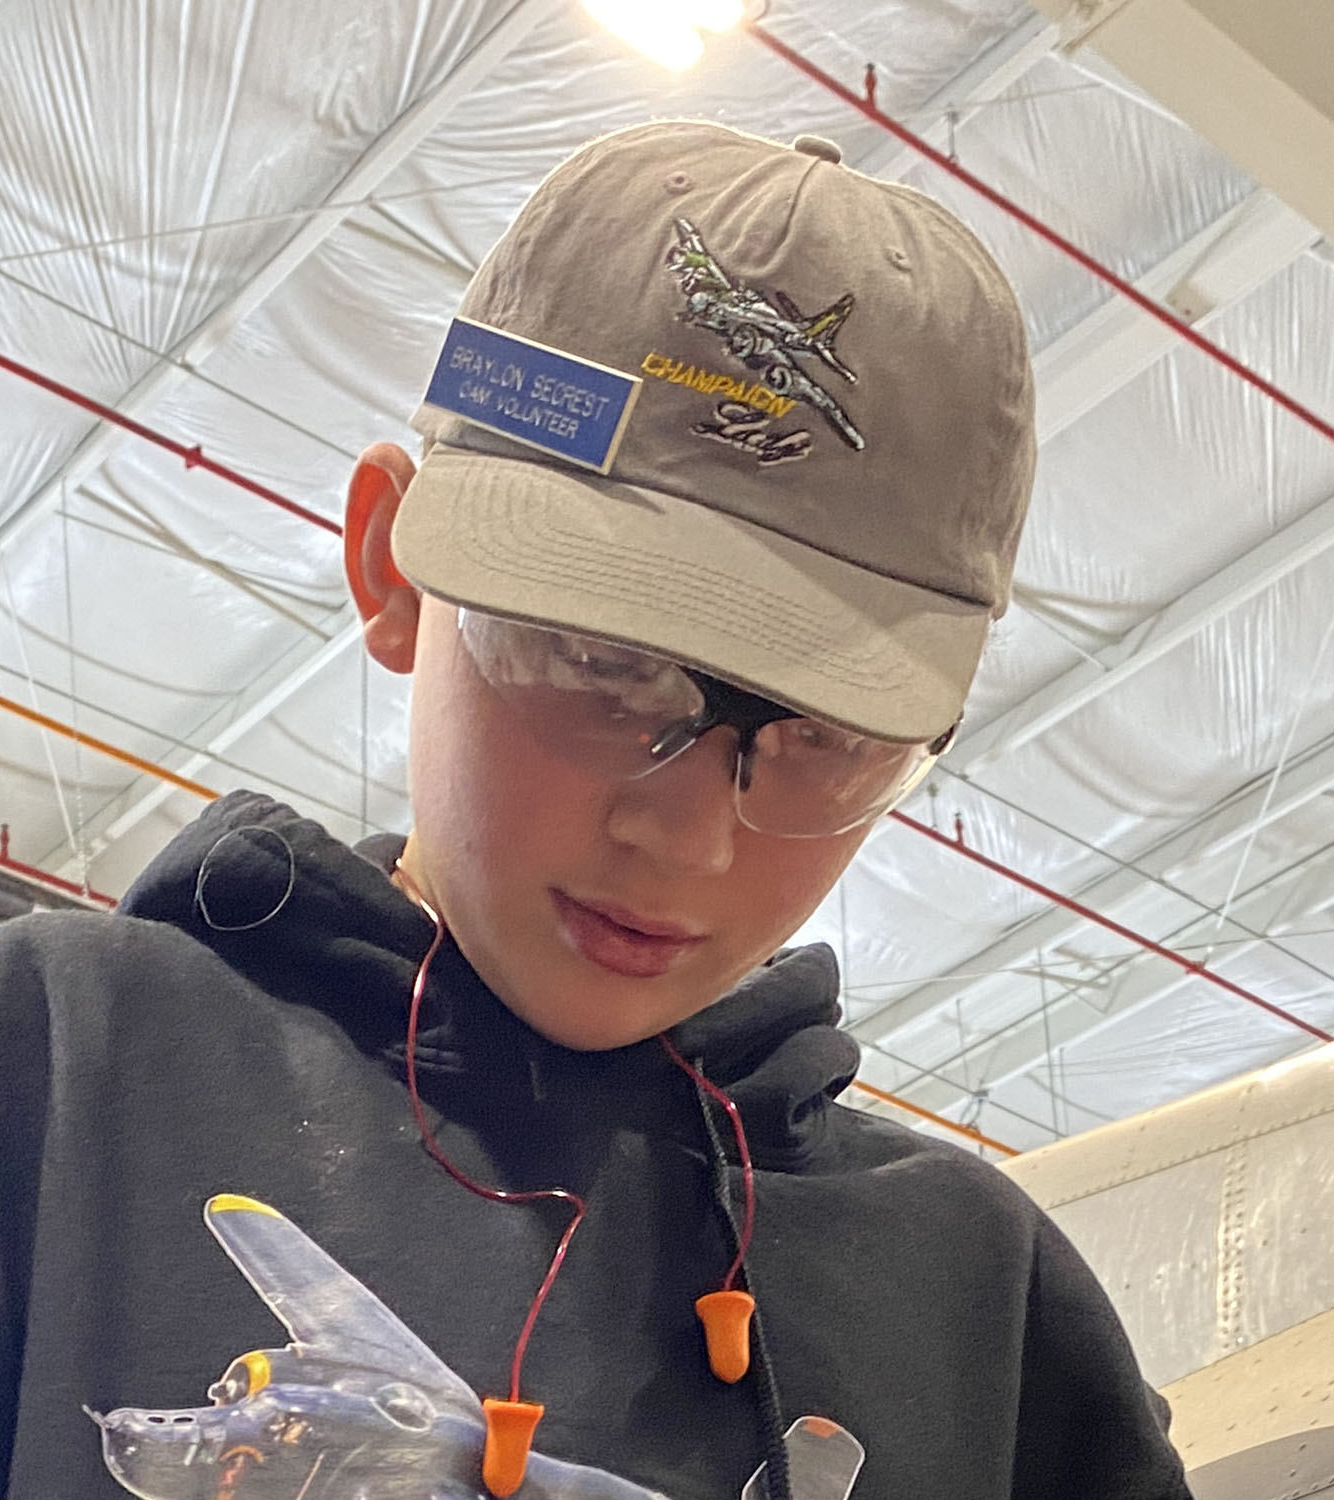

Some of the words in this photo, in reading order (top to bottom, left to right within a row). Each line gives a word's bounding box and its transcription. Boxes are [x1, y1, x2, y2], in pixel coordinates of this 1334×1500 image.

[450, 346, 525, 392] BRAYLON
[530, 373, 610, 421] SECREST
[497, 397, 580, 440] VOLUNTEER
